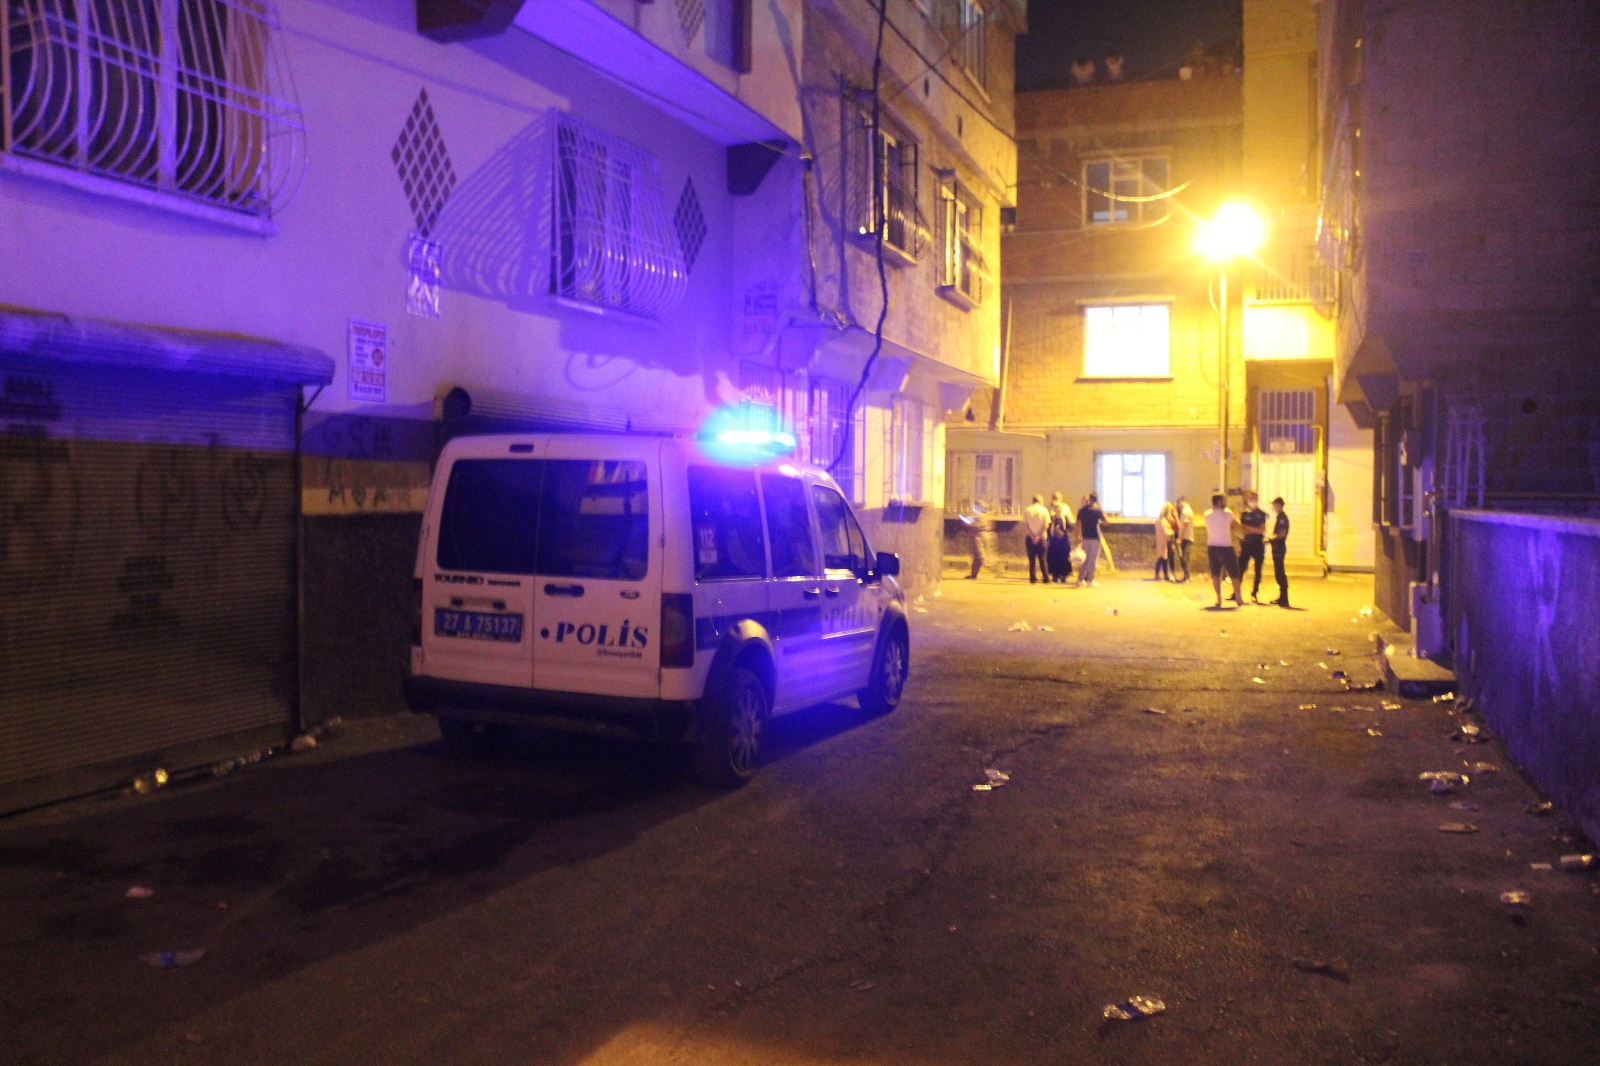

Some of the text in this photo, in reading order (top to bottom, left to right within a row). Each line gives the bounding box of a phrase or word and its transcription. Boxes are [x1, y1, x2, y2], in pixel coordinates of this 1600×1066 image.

[699, 527, 715, 548] 112
[443, 612, 517, 635] 27 A 75137
[556, 619, 649, 649] POLİS
